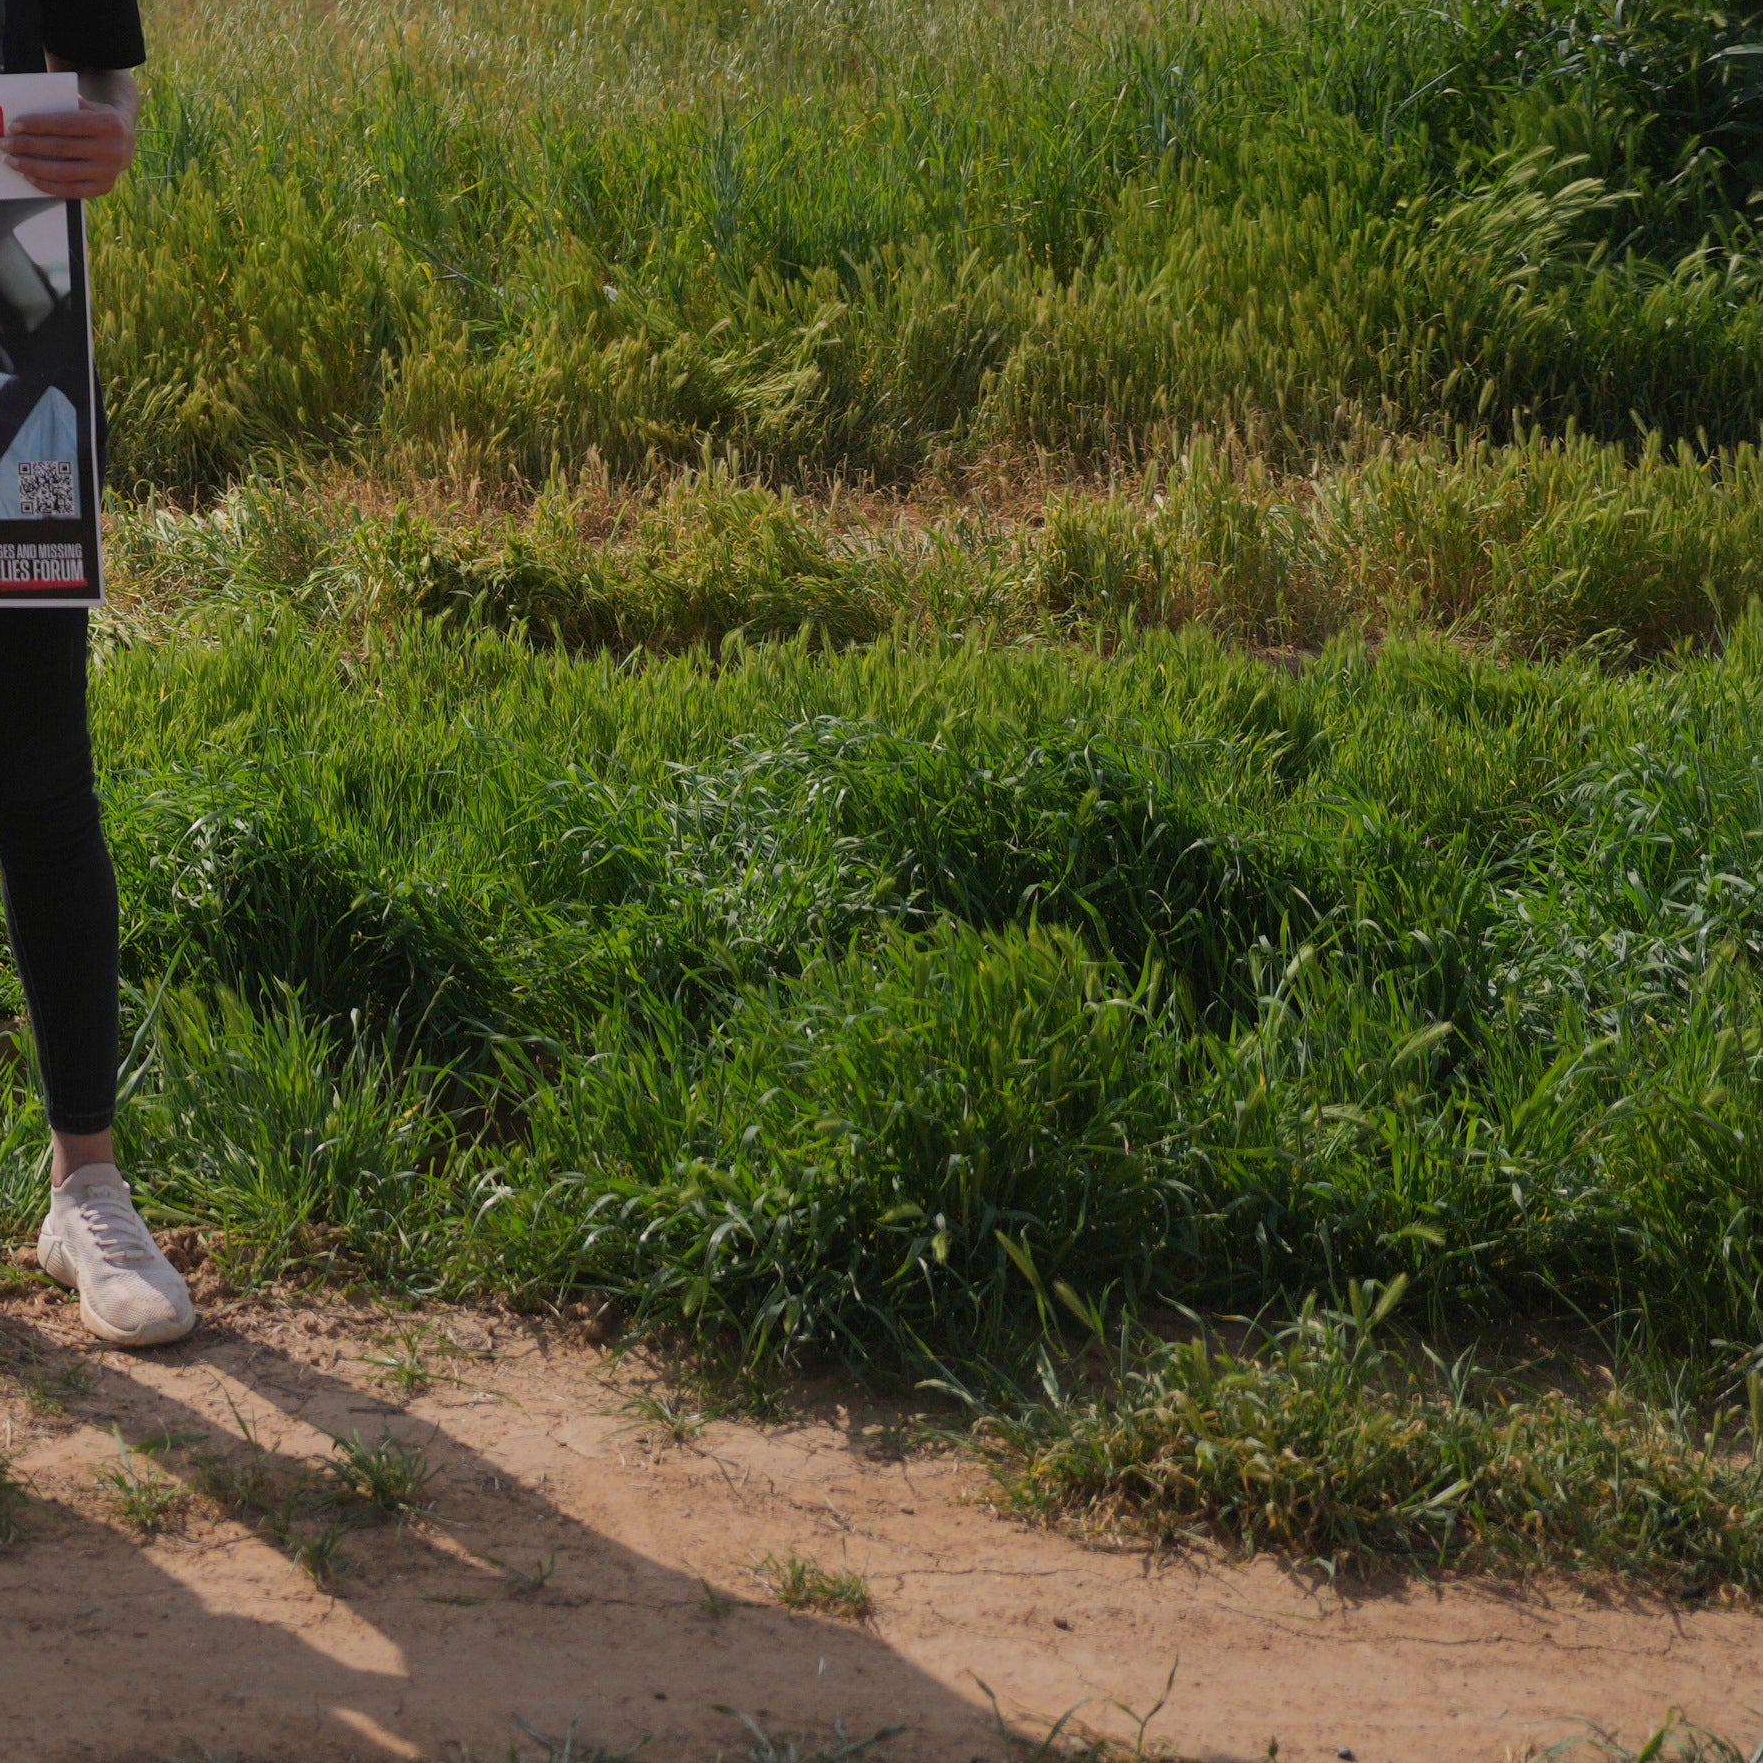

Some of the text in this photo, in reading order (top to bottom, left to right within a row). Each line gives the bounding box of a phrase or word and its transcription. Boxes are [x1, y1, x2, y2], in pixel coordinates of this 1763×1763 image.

[16, 543, 37, 558] AND
[37, 542, 83, 558] MISSING
[33, 558, 84, 581] FORUM
